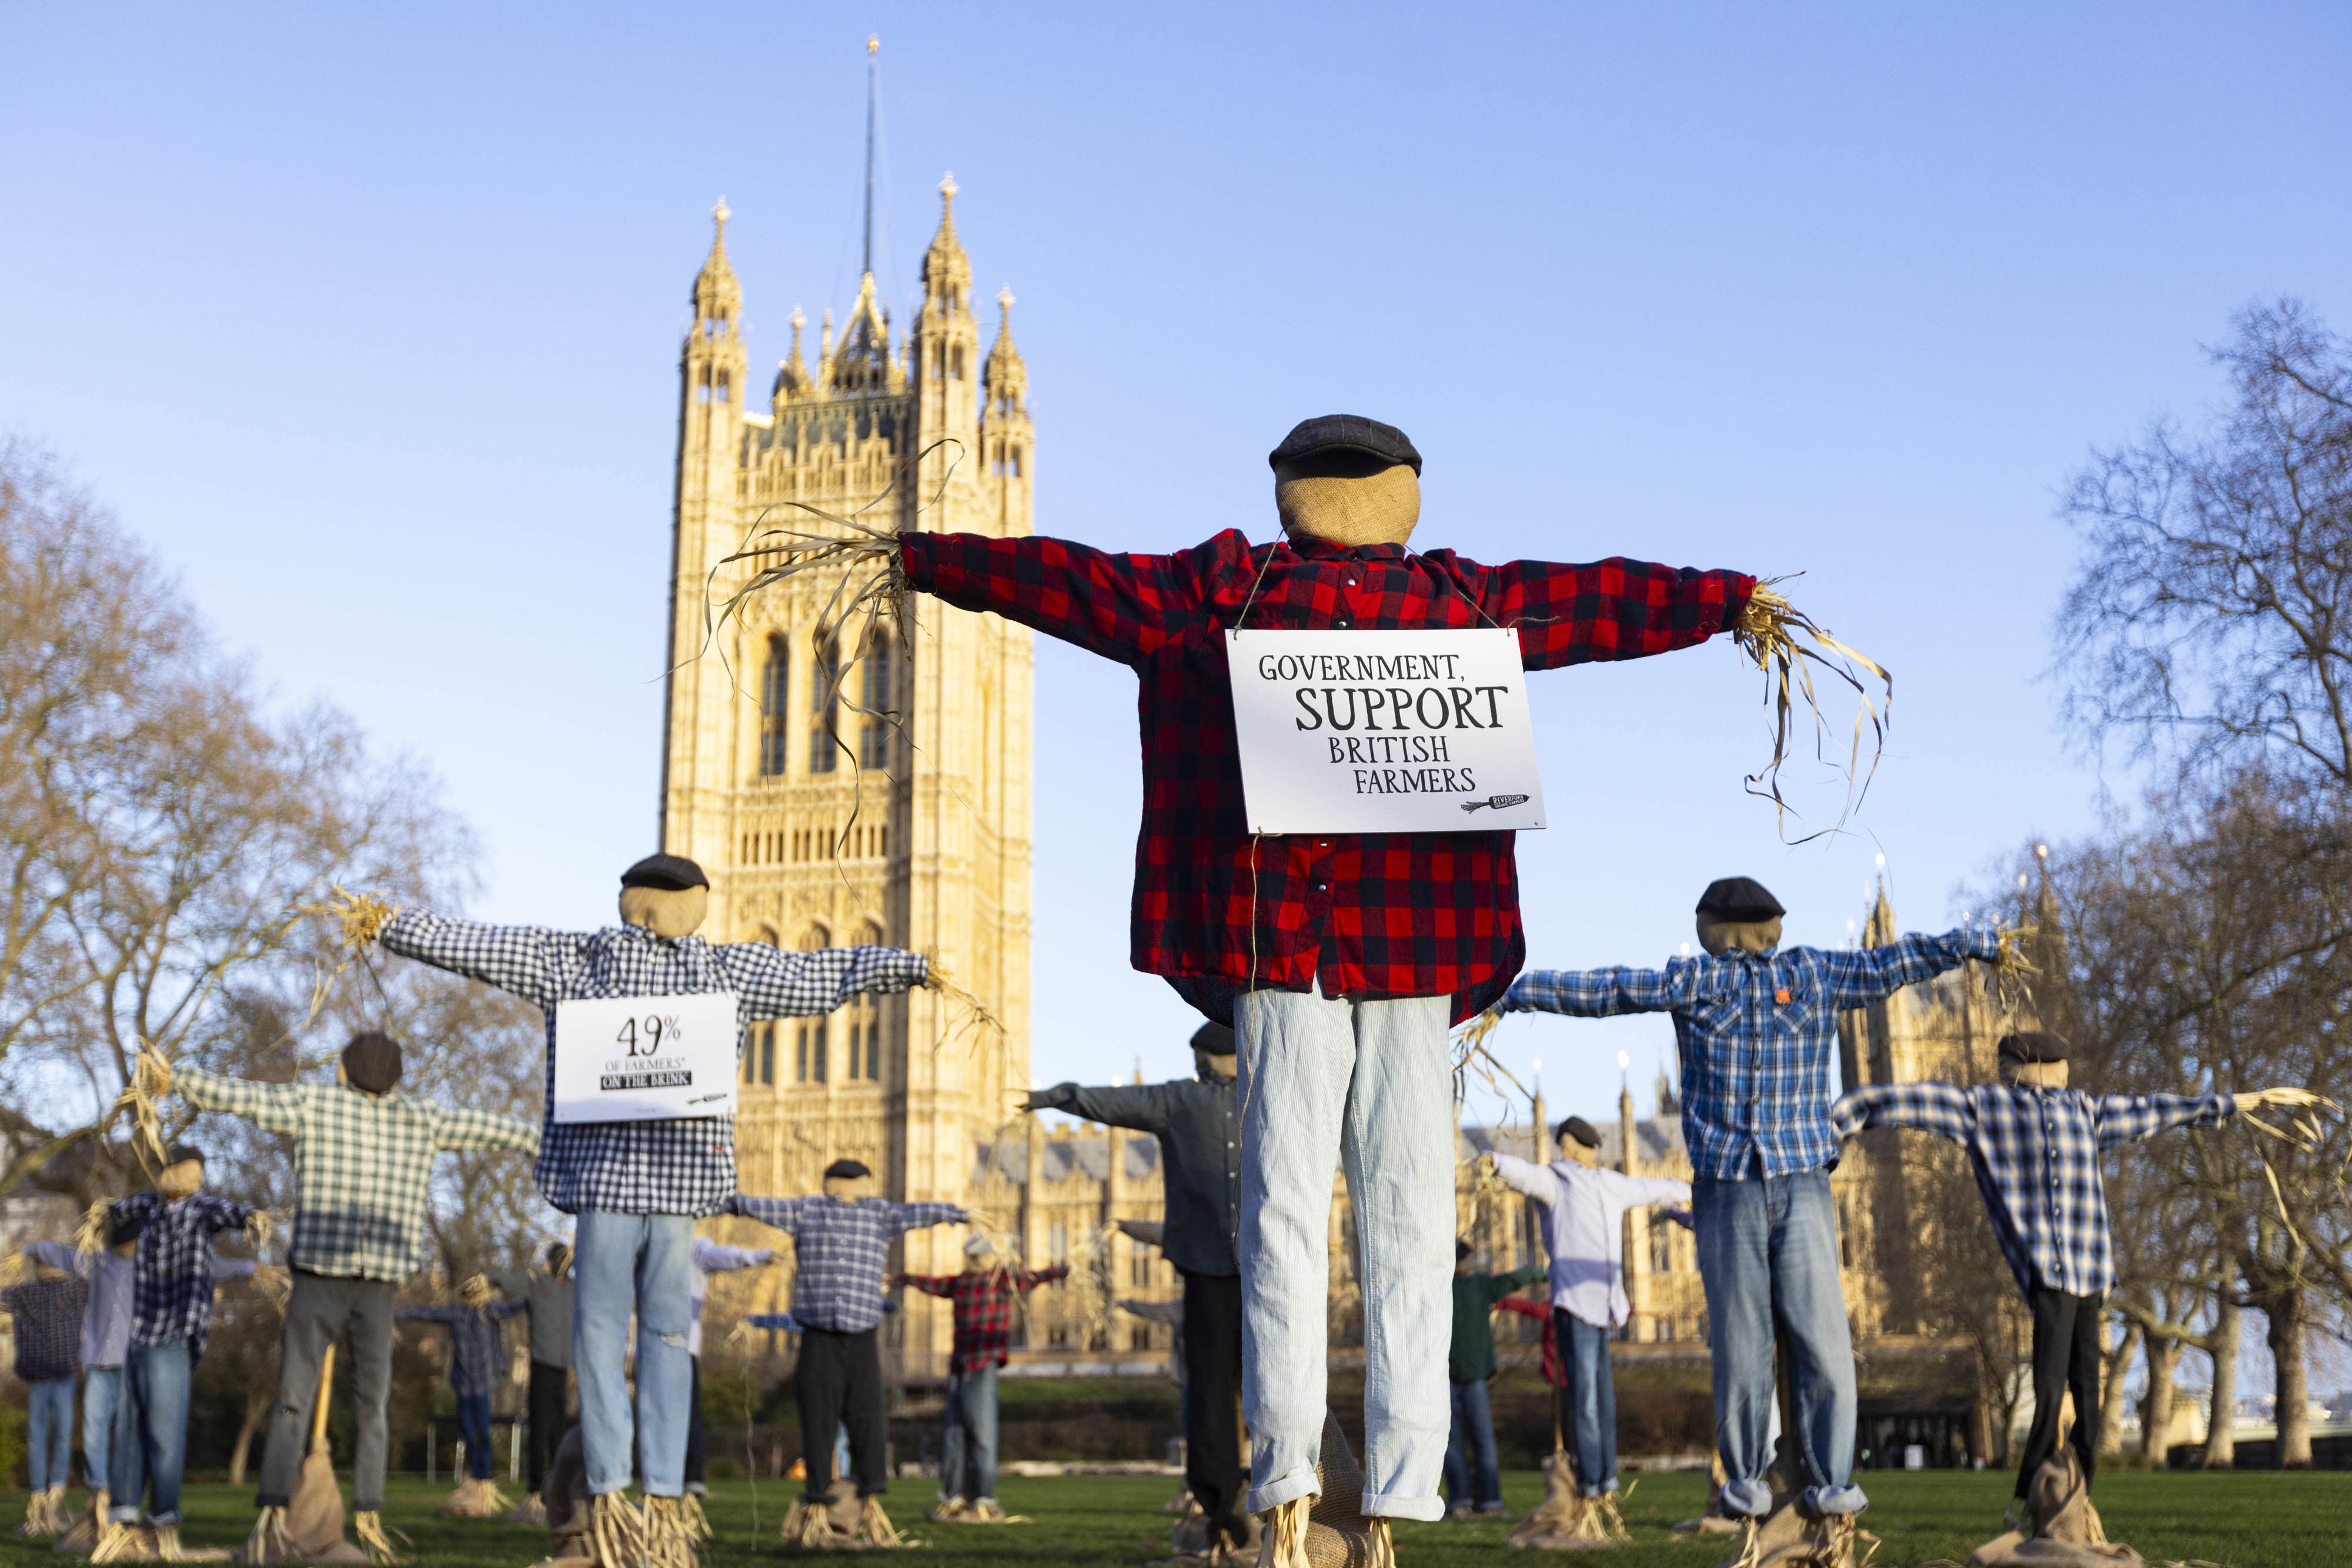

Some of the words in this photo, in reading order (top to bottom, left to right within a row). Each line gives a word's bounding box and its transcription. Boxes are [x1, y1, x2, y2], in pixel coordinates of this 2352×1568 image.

[1258, 654, 1465, 682] GOVERNMENT,
[1295, 686, 1509, 731] SUPPORT
[1328, 735, 1451, 764] BRITISH
[1353, 767, 1476, 794] FARMERS
[1492, 795, 1524, 805] RIVERFORD
[616, 1015, 681, 1057] 49%
[602, 1075, 621, 1088] ON
[623, 1074, 647, 1087] THE
[650, 1071, 689, 1086] BRINK
[605, 1061, 620, 1072] OF
